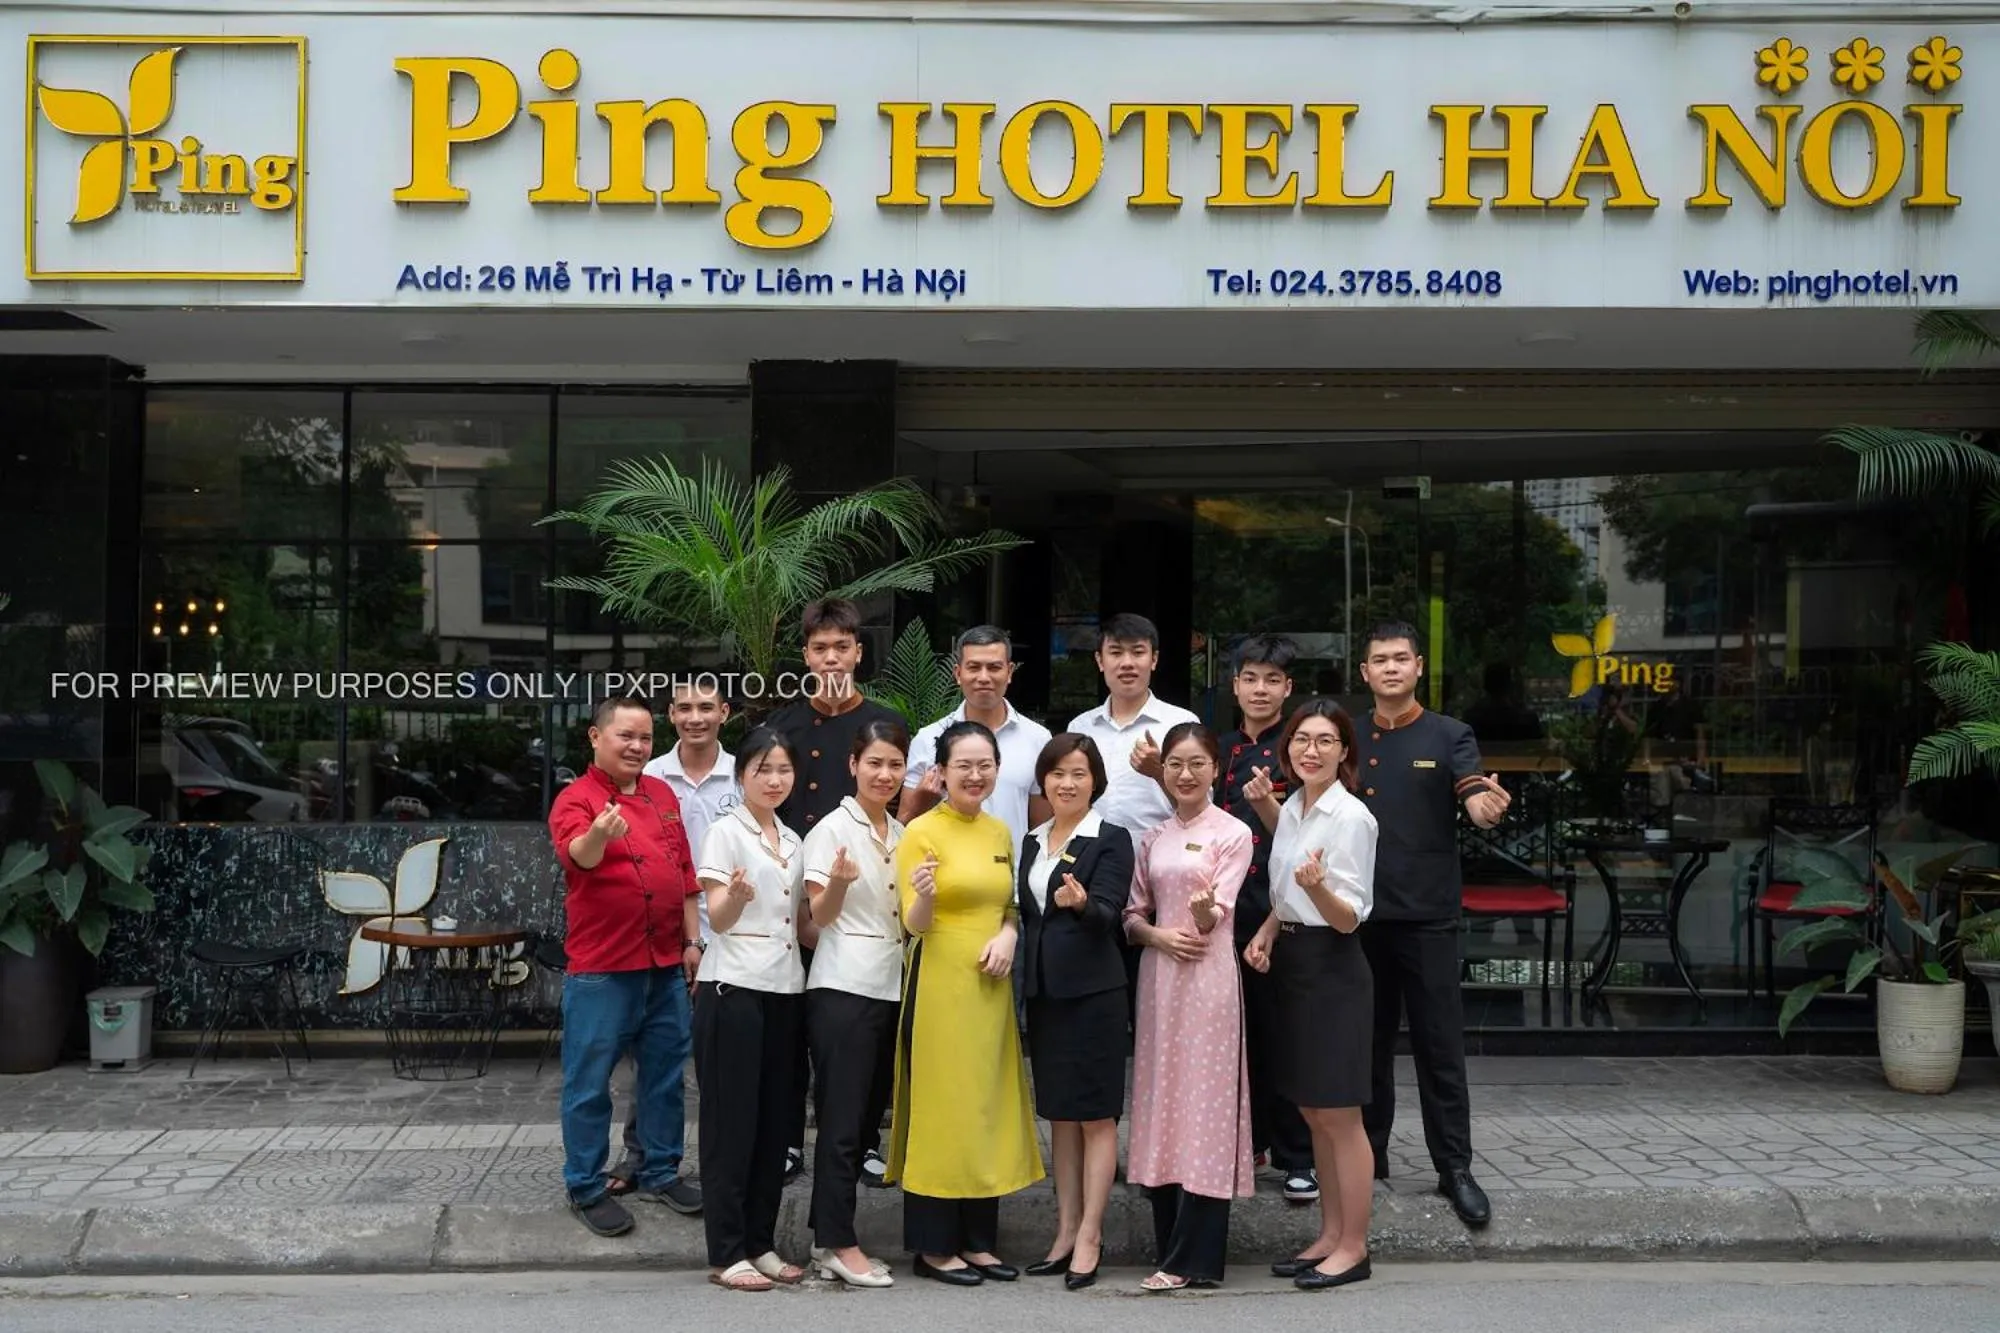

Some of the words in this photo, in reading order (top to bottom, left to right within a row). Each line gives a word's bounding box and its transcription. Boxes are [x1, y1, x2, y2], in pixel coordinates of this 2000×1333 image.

[392, 47, 837, 250] Ping
[876, 98, 1395, 208] HOTEL
[1427, 103, 1660, 211] HA
[128, 135, 298, 211] Ping
[396, 263, 473, 292] Add:
[477, 265, 516, 291] 26
[525, 260, 571, 292] Mễ
[581, 266, 622, 293] Trì
[632, 267, 674, 299] Hạ
[681, 277, 692, 287] -
[700, 268, 745, 294] Từ
[756, 268, 834, 295] Liêm
[842, 279, 853, 288] -
[862, 269, 904, 294] Hà
[915, 268, 966, 301] Nội
[1206, 269, 1262, 295] Tel:
[1269, 269, 1503, 296] 024.3785.8408
[1683, 270, 1759, 296] Web:
[1767, 269, 1959, 301] pinghotel.vn
[1597, 656, 1676, 693] Ping
